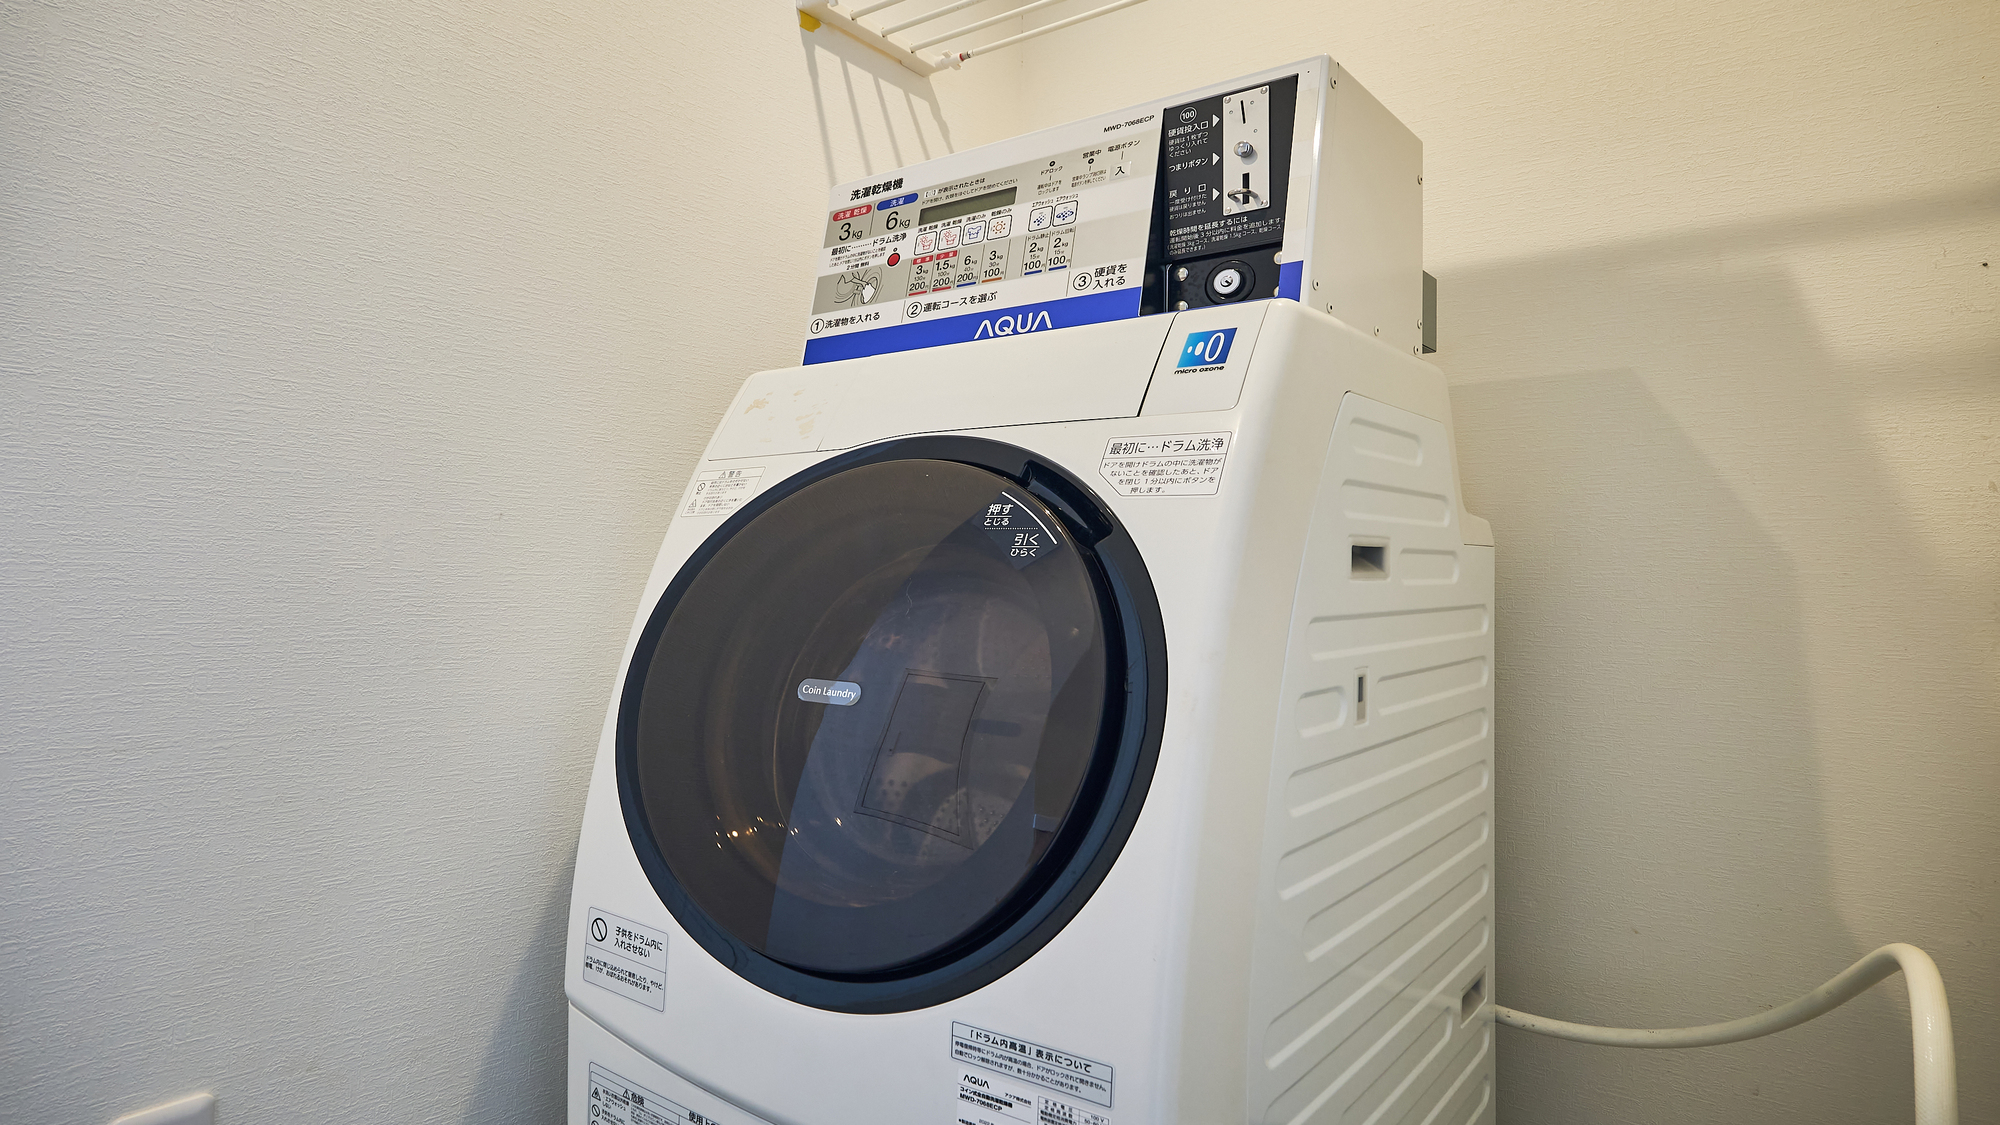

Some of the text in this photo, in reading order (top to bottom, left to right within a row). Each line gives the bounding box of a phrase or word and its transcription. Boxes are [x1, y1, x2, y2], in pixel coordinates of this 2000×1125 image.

[1182, 110, 1195, 120] 100
[1103, 115, 1155, 133] MWD-7068ECP
[1168, 121, 1209, 137] 硬貨投入口
[1107, 140, 1141, 152] 電源ボタン
[1168, 137, 1208, 152] ゆっくり入れて
[1082, 149, 1102, 159] 営業中
[1169, 148, 1192, 158] ください
[1040, 166, 1063, 176] ドアロック
[1114, 165, 1125, 176] 入
[1168, 158, 1209, 172] つまりボタン
[850, 178, 904, 201] 洗濯乾燥機
[890, 198, 905, 208] 洗濯
[837, 210, 851, 220] 洗濯
[991, 208, 1013, 217] 乾燥のみ
[1168, 208, 1207, 220] おつりは出ません
[1169, 215, 1248, 237] 乾燥時間を延長するには
[1094, 263, 1128, 278] 硬貨を
[1092, 275, 1126, 291] 入れる
[973, 310, 1053, 340] AQUA
[1199, 365, 1225, 373] ozone
[1103, 457, 1224, 469] ドアを開けドラムの中に洗濯物が
[1109, 466, 1219, 478] ないことを確認したあと、ドア
[1129, 486, 1167, 495] 押します。
[986, 503, 1014, 516] 押す
[983, 517, 1010, 526] とじる
[1014, 532, 1040, 546] 引く
[1010, 548, 1037, 557] ひらく
[802, 684, 857, 701] Coin Laundry
[615, 925, 663, 952] 子供をドラム内に
[613, 937, 651, 958] 入れさせない
[970, 1029, 1093, 1074] 「ドラム内高温」表示について
[963, 1073, 990, 1090] AQUA
[959, 1092, 1003, 1112] MWD-7068ECP
[1004, 1092, 1033, 1107] アクア株式会社
